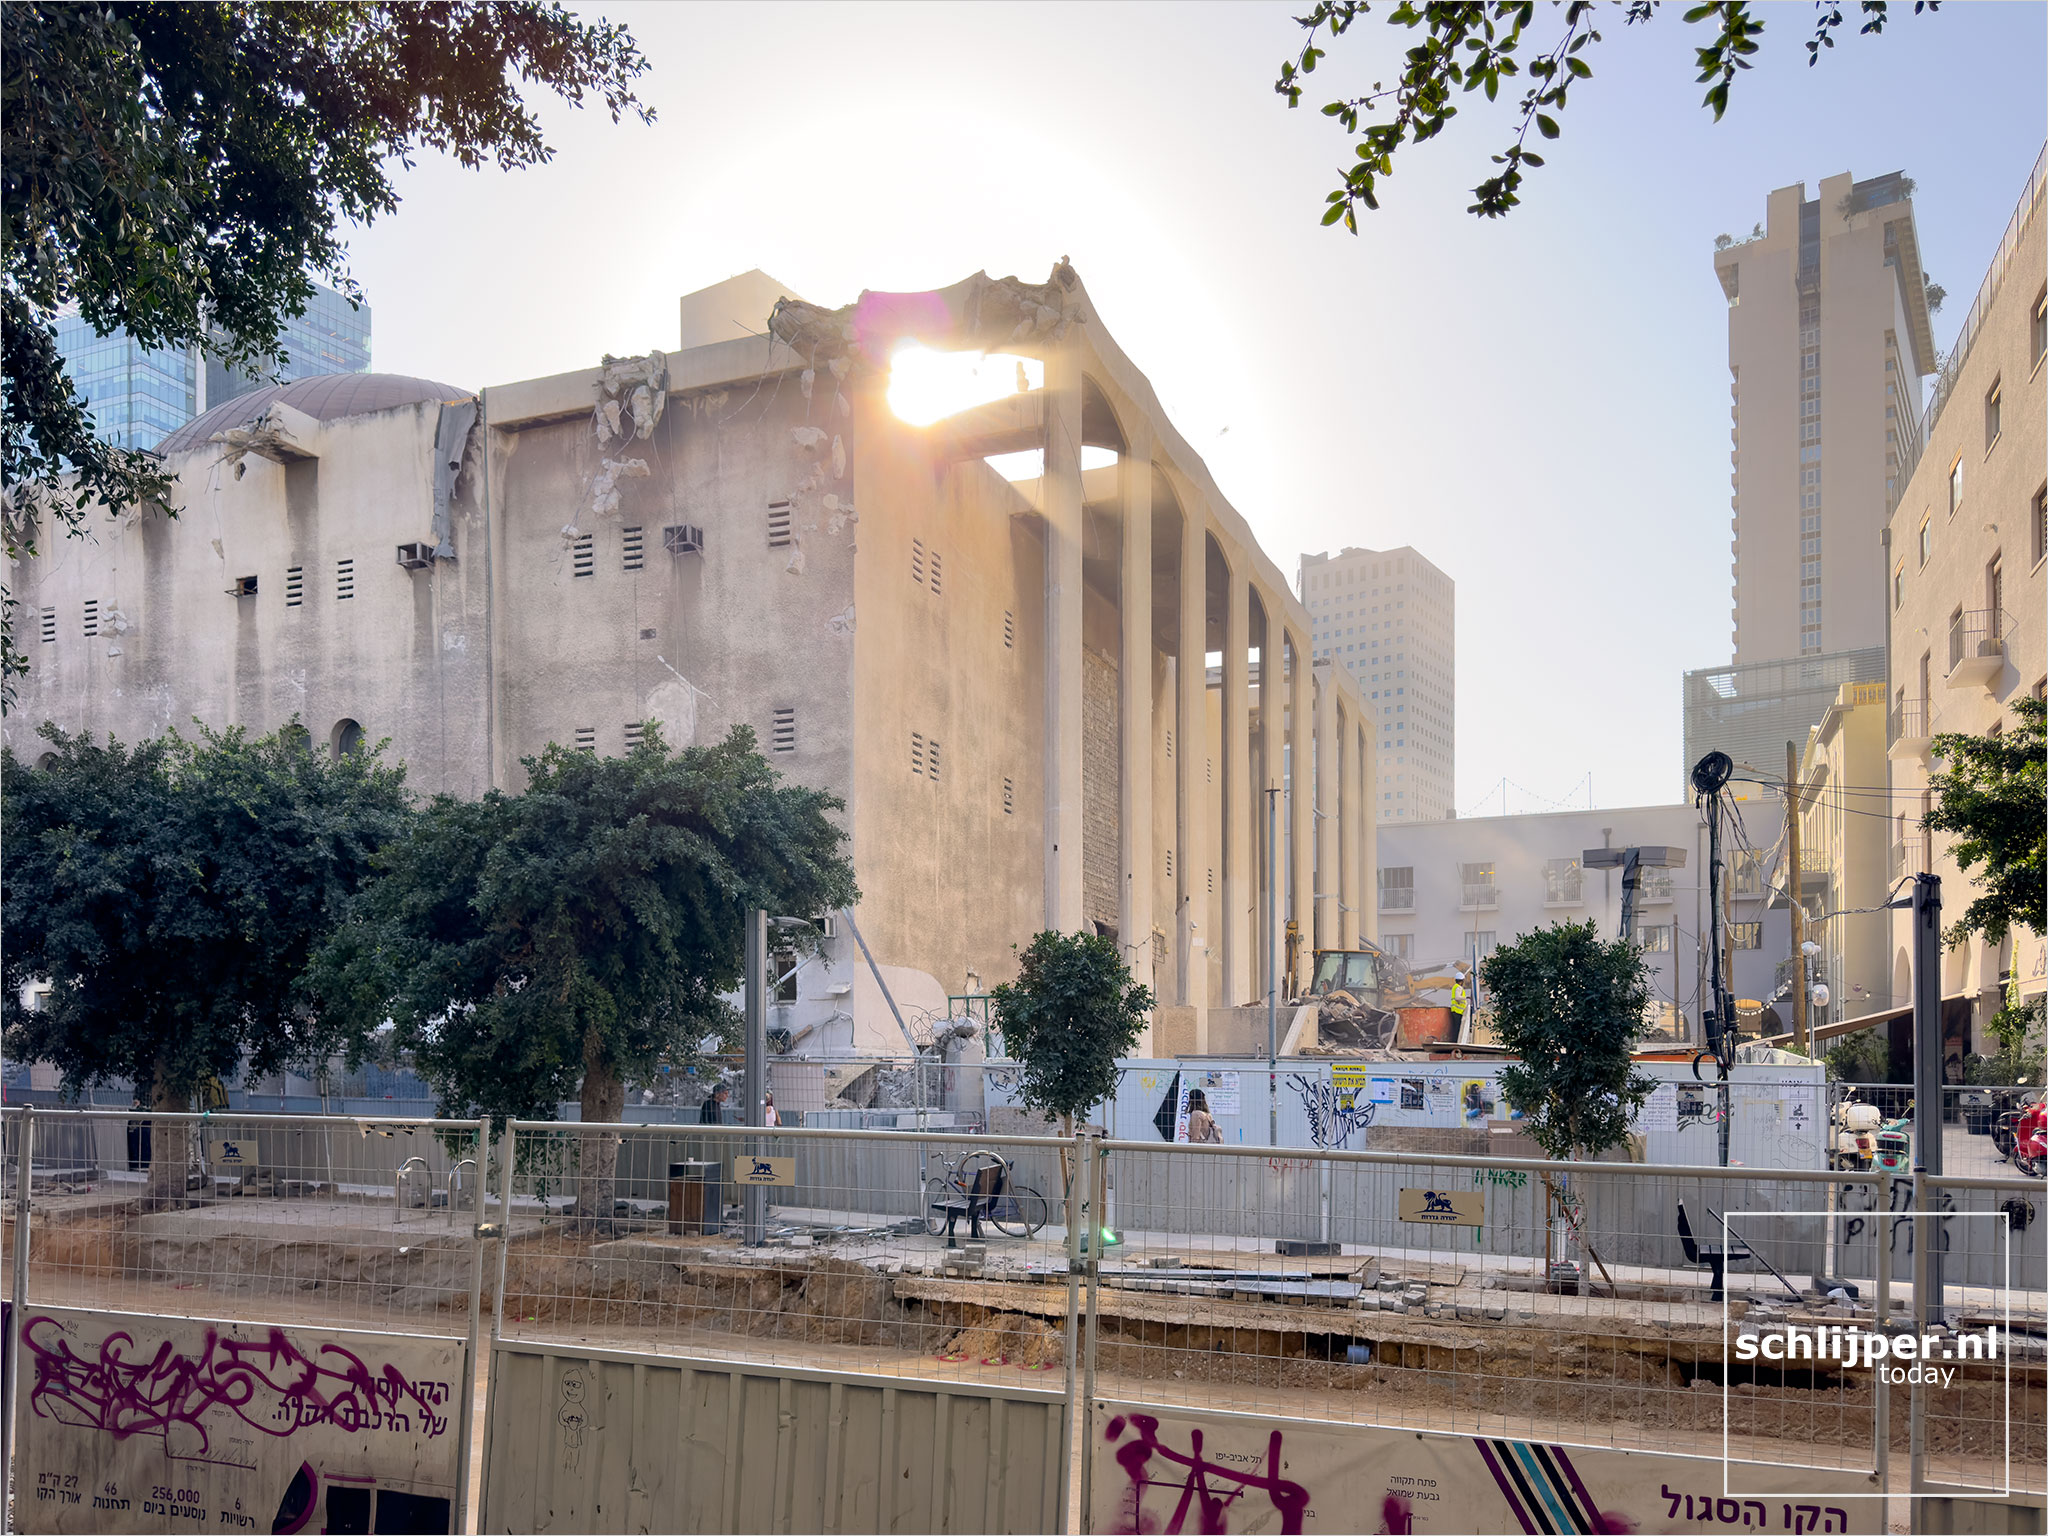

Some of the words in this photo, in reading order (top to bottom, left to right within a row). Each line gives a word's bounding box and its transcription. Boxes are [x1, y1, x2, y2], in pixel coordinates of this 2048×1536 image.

[343, 1407, 410, 1432] הרכבת
[418, 1408, 448, 1436] של
[1215, 1452, 1249, 1463] אביב-יפו
[1250, 1455, 1262, 1464] תל
[64, 1475, 79, 1488] 27
[104, 1481, 118, 1496] 46
[1390, 1475, 1416, 1487] תקווה
[1417, 1478, 1437, 1488] פתח
[36, 1486, 56, 1500] הקו
[59, 1489, 82, 1504] אורך
[152, 1486, 200, 1504] 256,000
[1386, 1487, 1415, 1499] שמואל
[1416, 1490, 1440, 1501] גבעת
[92, 1495, 131, 1511] תחנות
[143, 1500, 166, 1515] ביום
[234, 1497, 241, 1510] 6
[1661, 1484, 1767, 1527] הסגול
[170, 1503, 206, 1521] נוסעים
[220, 1510, 255, 1528] רשויות
[1782, 1503, 1848, 1535] הקו
